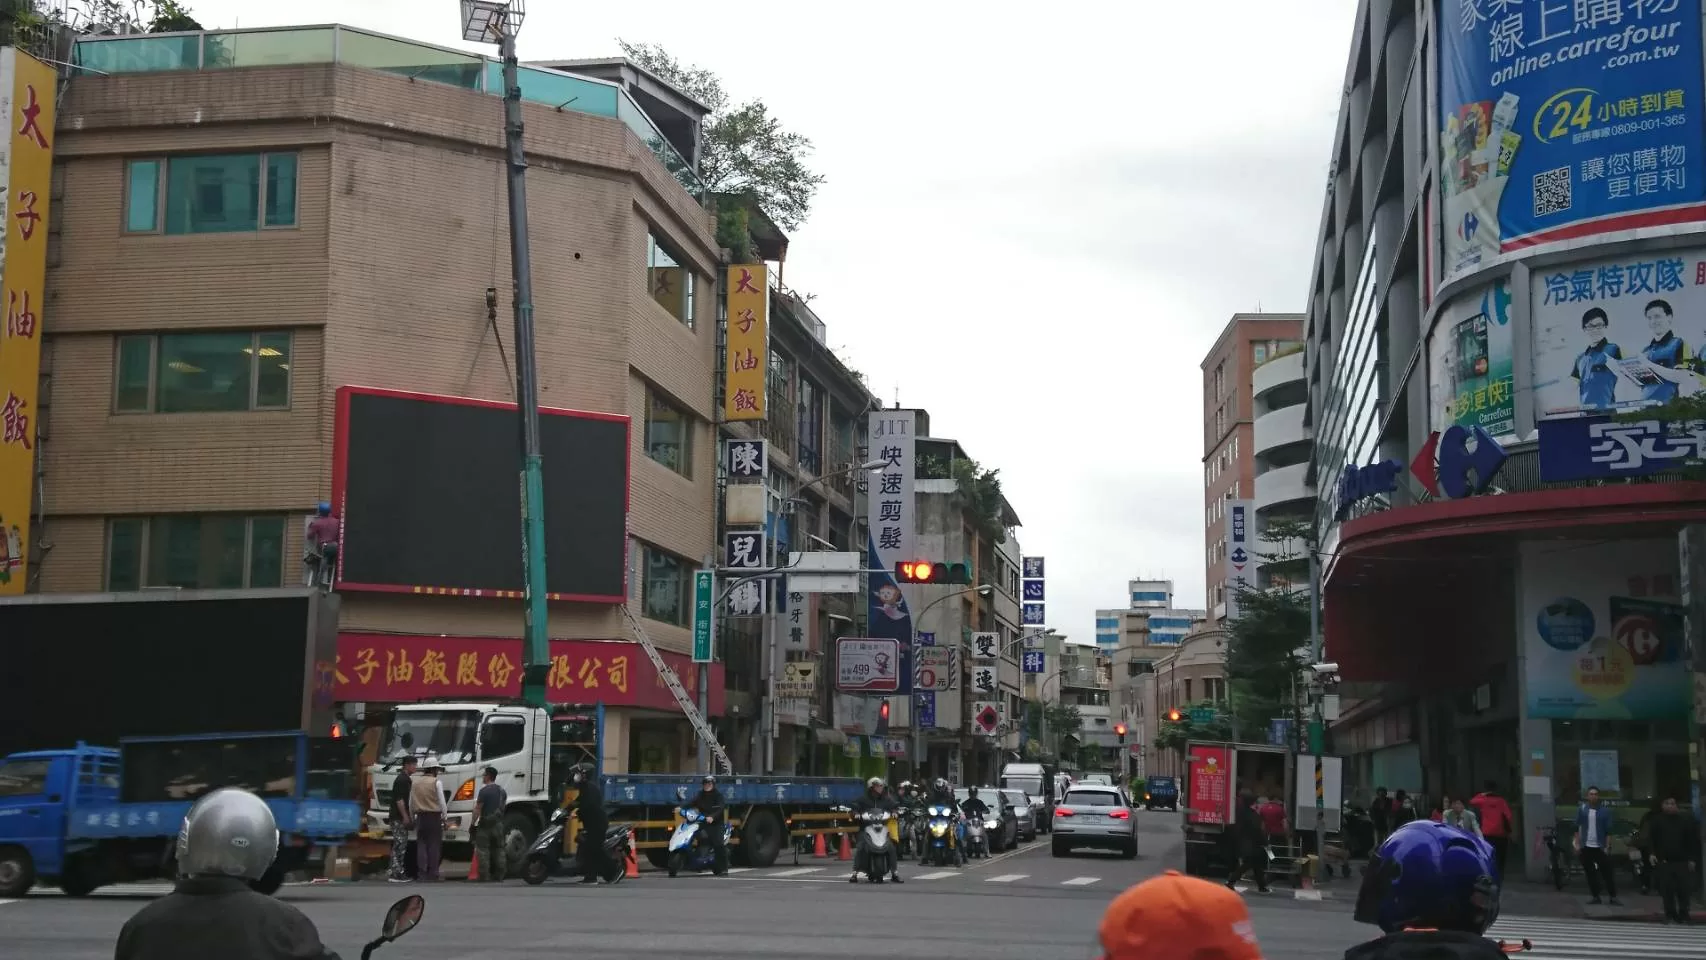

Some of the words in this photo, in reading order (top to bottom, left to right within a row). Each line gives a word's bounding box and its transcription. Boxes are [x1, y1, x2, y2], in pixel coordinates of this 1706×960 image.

[1491, 21, 1681, 86] online.carrefour
[1601, 44, 1680, 69] .com.tw
[1598, 89, 1685, 122] 小時到貨
[1582, 144, 1686, 182] 讓您購物
[1607, 166, 1686, 200] 更便利
[1, 84, 49, 450] 太子油飯
[1544, 257, 1685, 305] 冷氣特攻隊
[732, 268, 761, 413] 太子油飯
[879, 445, 903, 550] 快速剪髮
[852, 664, 870, 675] 499
[975, 635, 996, 693] 雙連
